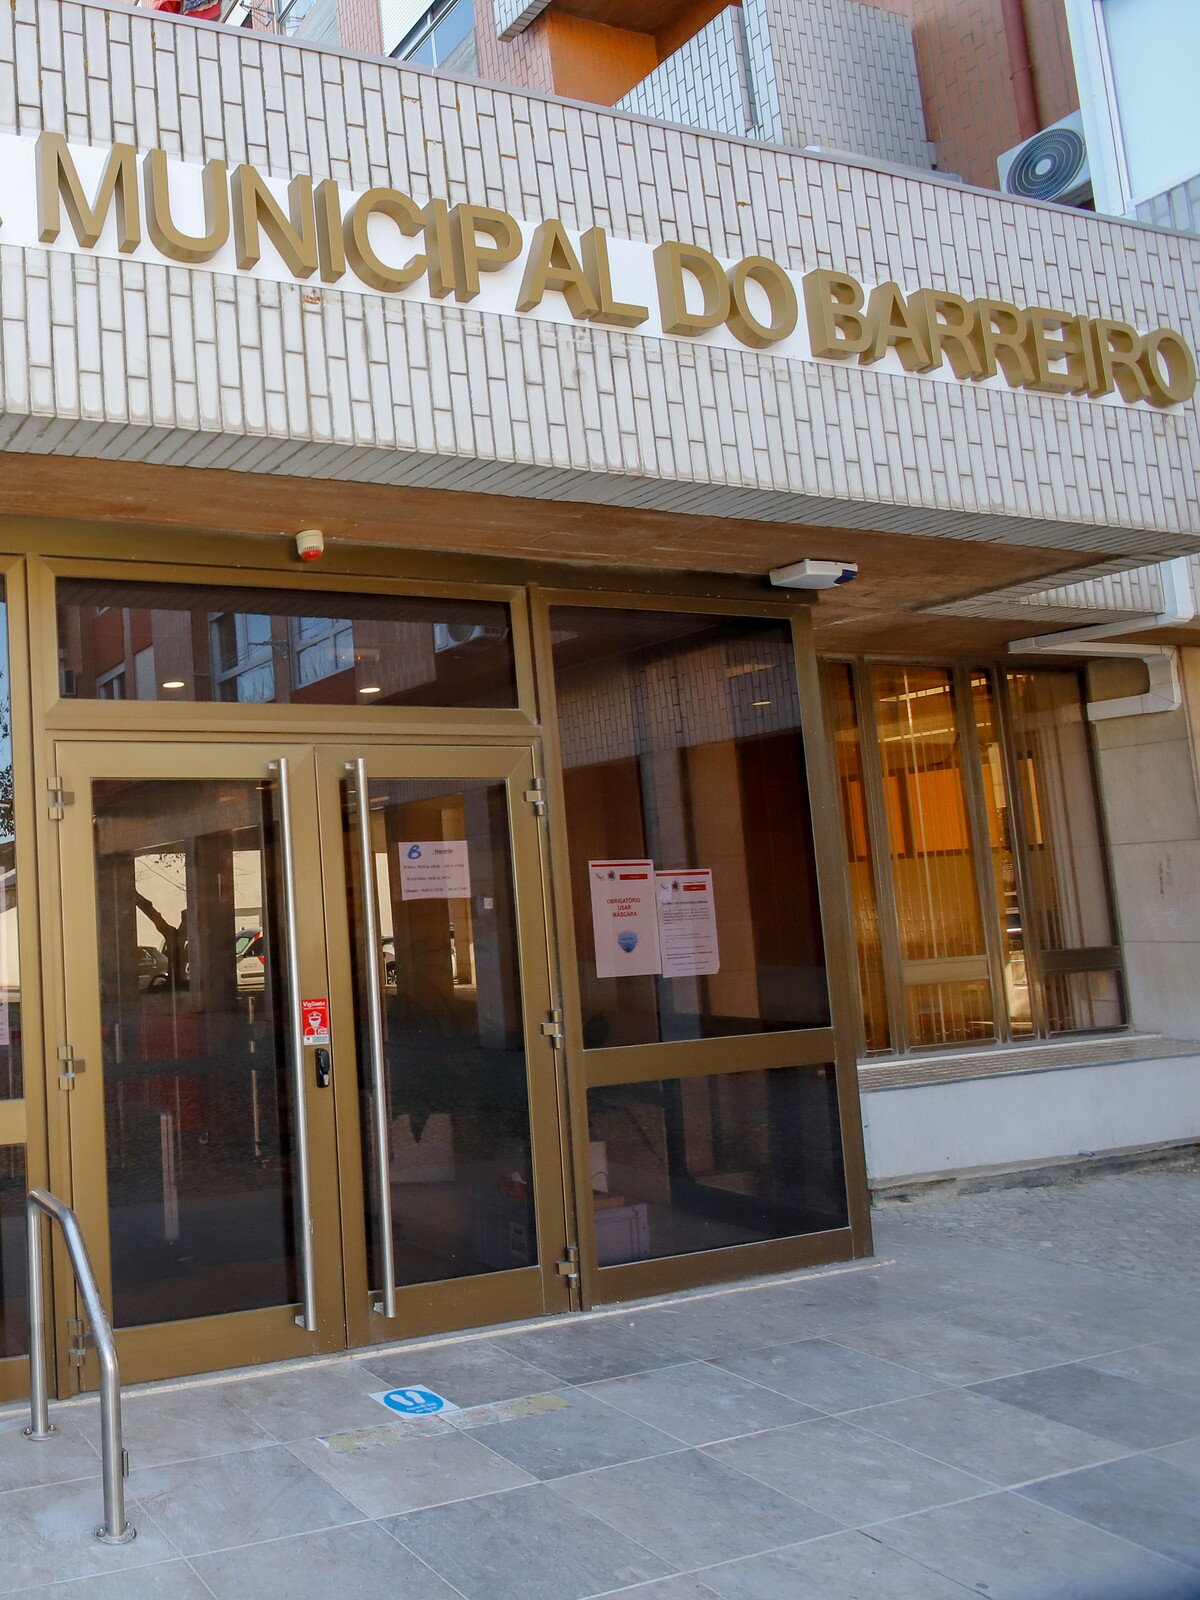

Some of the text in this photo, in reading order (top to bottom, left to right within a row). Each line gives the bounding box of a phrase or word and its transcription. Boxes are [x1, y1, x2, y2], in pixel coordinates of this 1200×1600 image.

[34, 130, 649, 329] MUNICIPAL
[653, 239, 799, 349] DO
[803, 268, 1198, 409] BARREIRO
[606, 897, 641, 905] OBRIGATÓRIO
[612, 910, 638, 918] MÁSCARA
